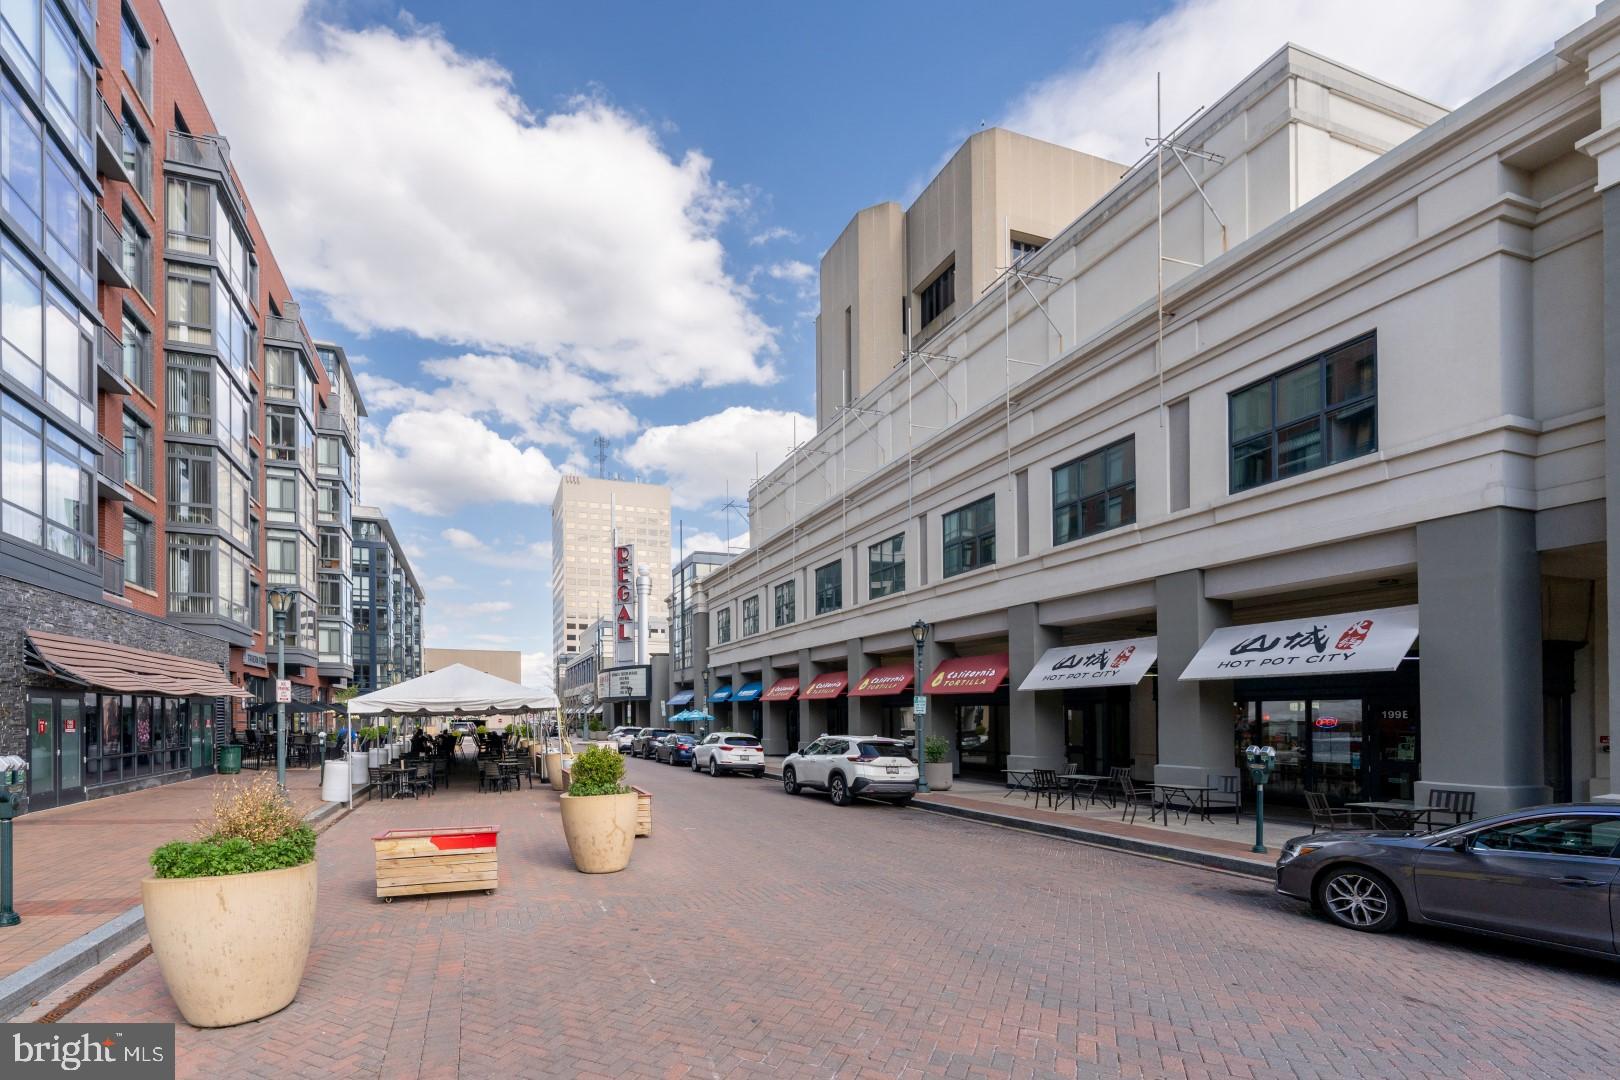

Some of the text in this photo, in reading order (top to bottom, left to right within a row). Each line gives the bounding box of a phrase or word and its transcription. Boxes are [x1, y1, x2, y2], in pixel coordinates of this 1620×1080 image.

[617, 547, 632, 640] REGAL
[1217, 652, 1356, 669] HOT POT CITY
[947, 668, 996, 679] California
[1066, 672, 1090, 680] POT
[1091, 669, 1121, 678] CITY
[870, 675, 905, 684] California
[943, 679, 987, 687] TORTILLA
[1381, 710, 1409, 719] 199E
[1316, 718, 1337, 727] OPEN
